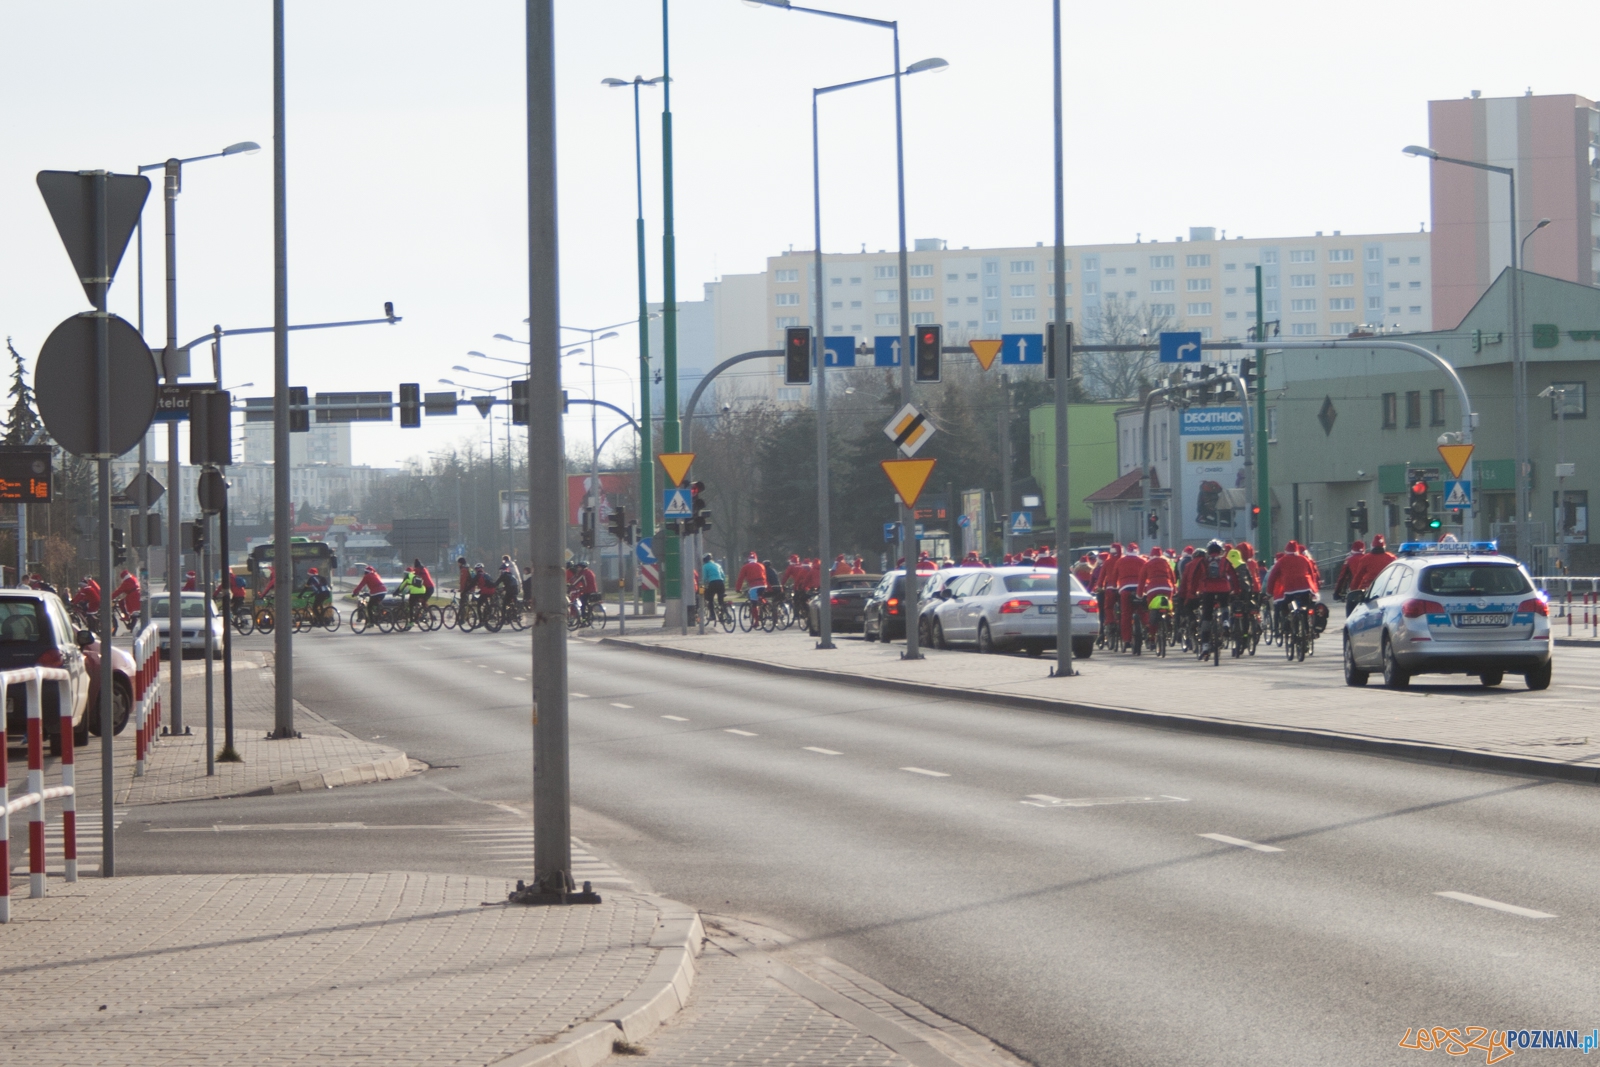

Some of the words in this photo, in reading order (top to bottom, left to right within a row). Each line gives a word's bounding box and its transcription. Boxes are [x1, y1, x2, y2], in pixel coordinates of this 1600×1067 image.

[1192, 442, 1215, 460] 119
[1440, 543, 1469, 551] POLICJA
[1463, 615, 1481, 625] HPU
[1484, 614, 1504, 625] C909
